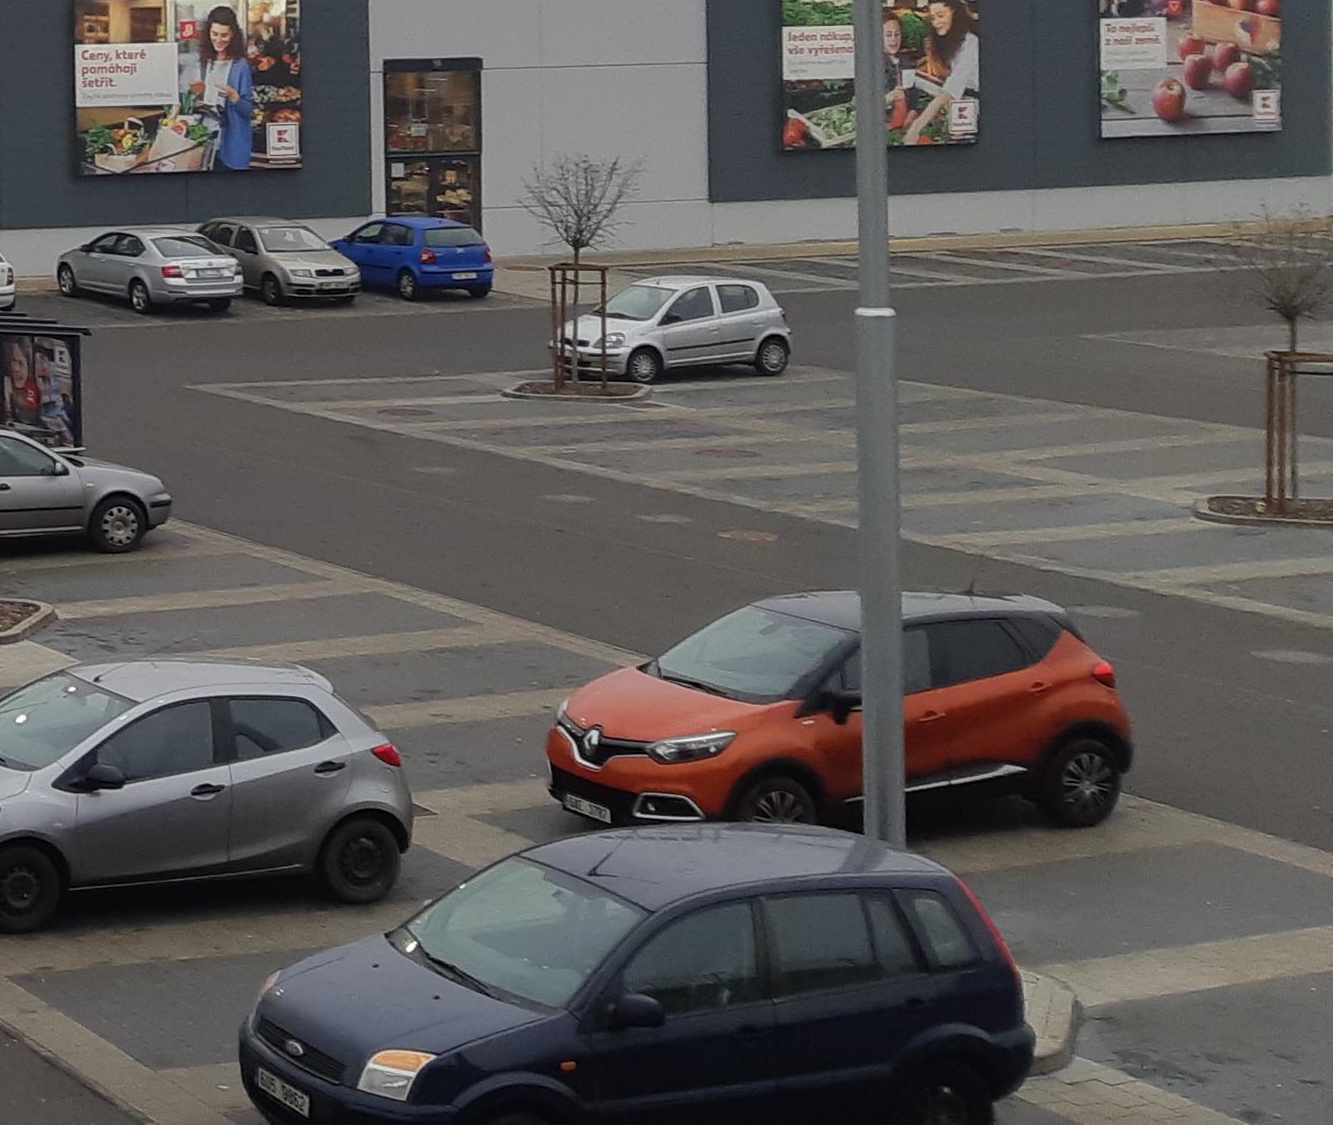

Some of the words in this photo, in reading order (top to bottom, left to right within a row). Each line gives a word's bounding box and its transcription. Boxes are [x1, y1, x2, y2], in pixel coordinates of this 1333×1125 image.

[81, 49, 113, 63] Ceny,
[115, 48, 147, 60] které
[81, 62, 138, 76] pomáhají
[81, 76, 118, 88] šetřit.
